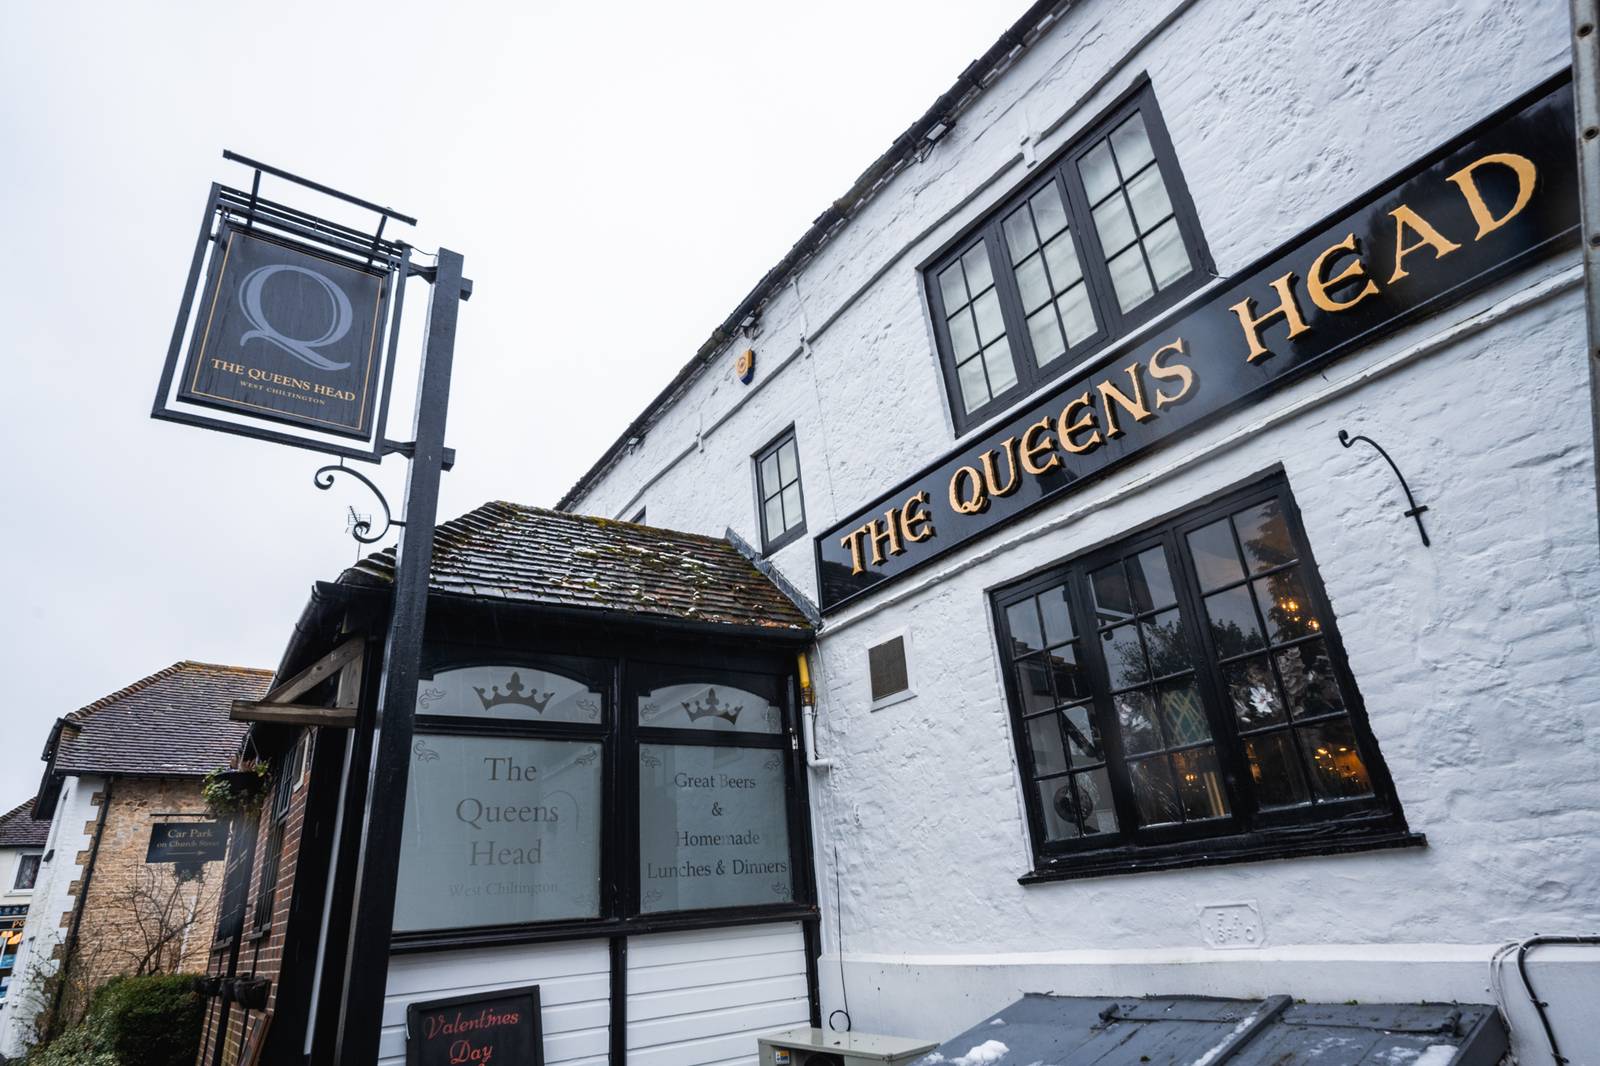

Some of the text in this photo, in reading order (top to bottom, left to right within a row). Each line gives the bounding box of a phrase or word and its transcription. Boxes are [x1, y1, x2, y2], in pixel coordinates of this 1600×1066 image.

[238, 264, 353, 371] Q
[841, 153, 1537, 576] THE QUEENS HEAD
[211, 358, 356, 402] THE QUEENS HEAD
[240, 380, 326, 406] WEST CHILTINGTON
[484, 756, 537, 782] The
[674, 772, 757, 789] Great Beers
[456, 797, 559, 830] Queens
[711, 801, 723, 817] &
[167, 828, 213, 838] Car Park
[675, 830, 760, 847] Homemade
[469, 838, 542, 866] Head
[647, 858, 787, 879] Lunches & Dinners
[450, 881, 559, 897] West Chiltington
[423, 1008, 521, 1040] Valentines
[450, 1040, 493, 1064] Day
